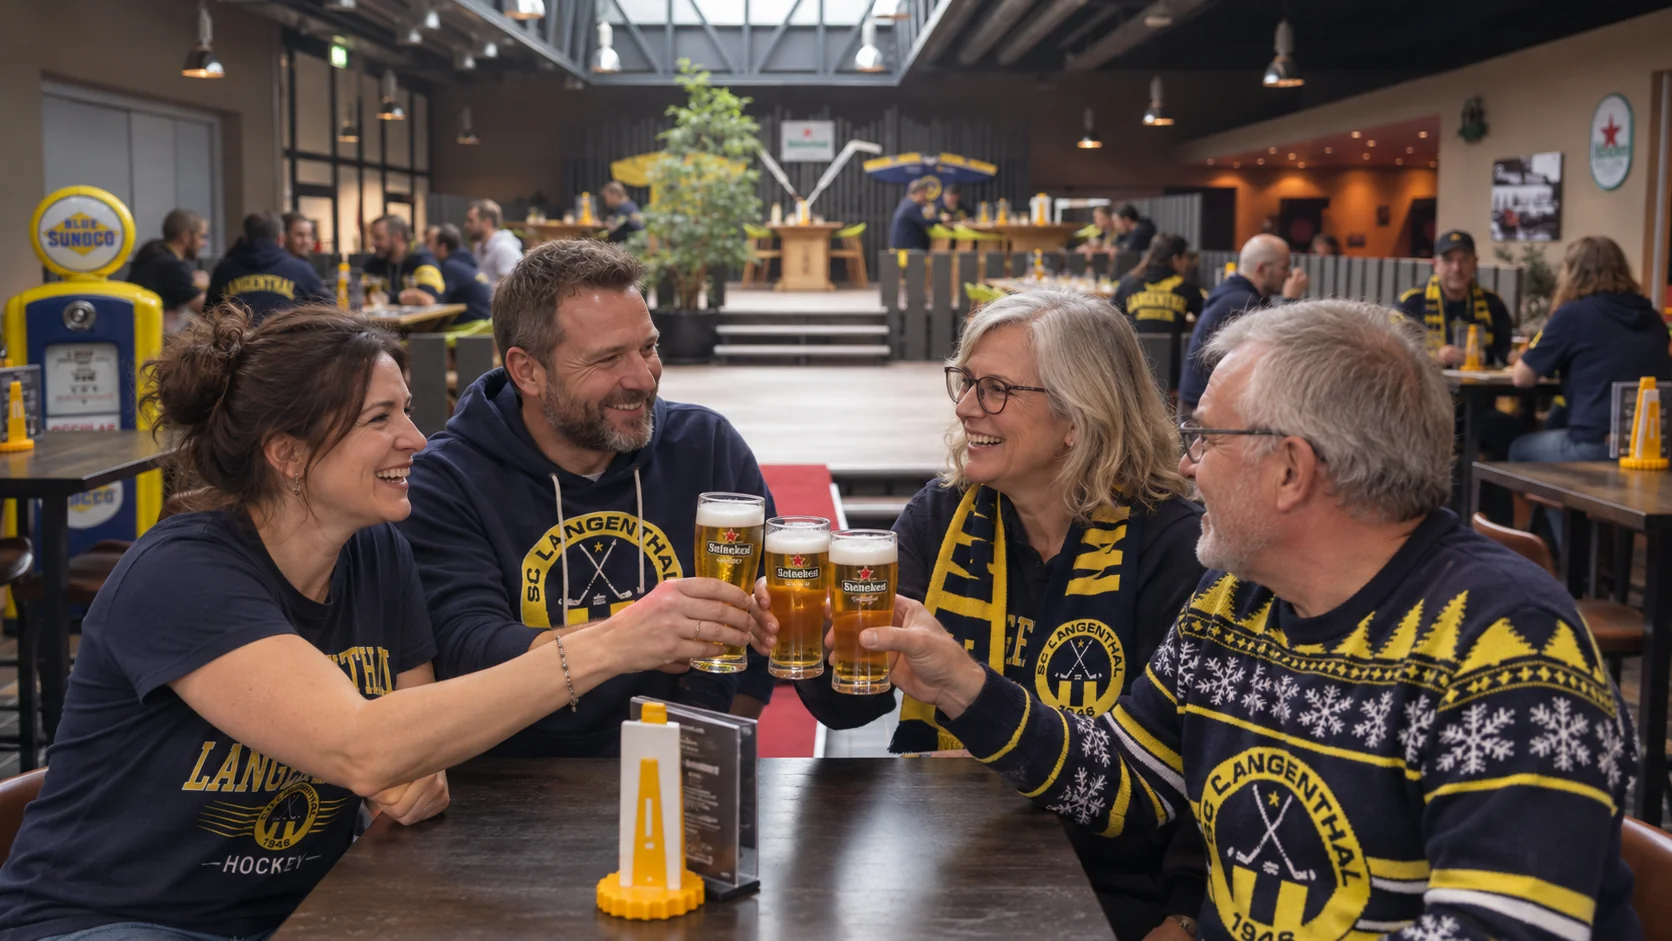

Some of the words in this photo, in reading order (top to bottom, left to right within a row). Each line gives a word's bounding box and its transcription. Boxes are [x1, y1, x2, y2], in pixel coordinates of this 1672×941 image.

[64, 219, 97, 229] BLUE
[48, 230, 114, 247] SUNOCO
[526, 568, 541, 603] SC
[1037, 652, 1049, 675] SC
[222, 853, 307, 875] HOCKEY
